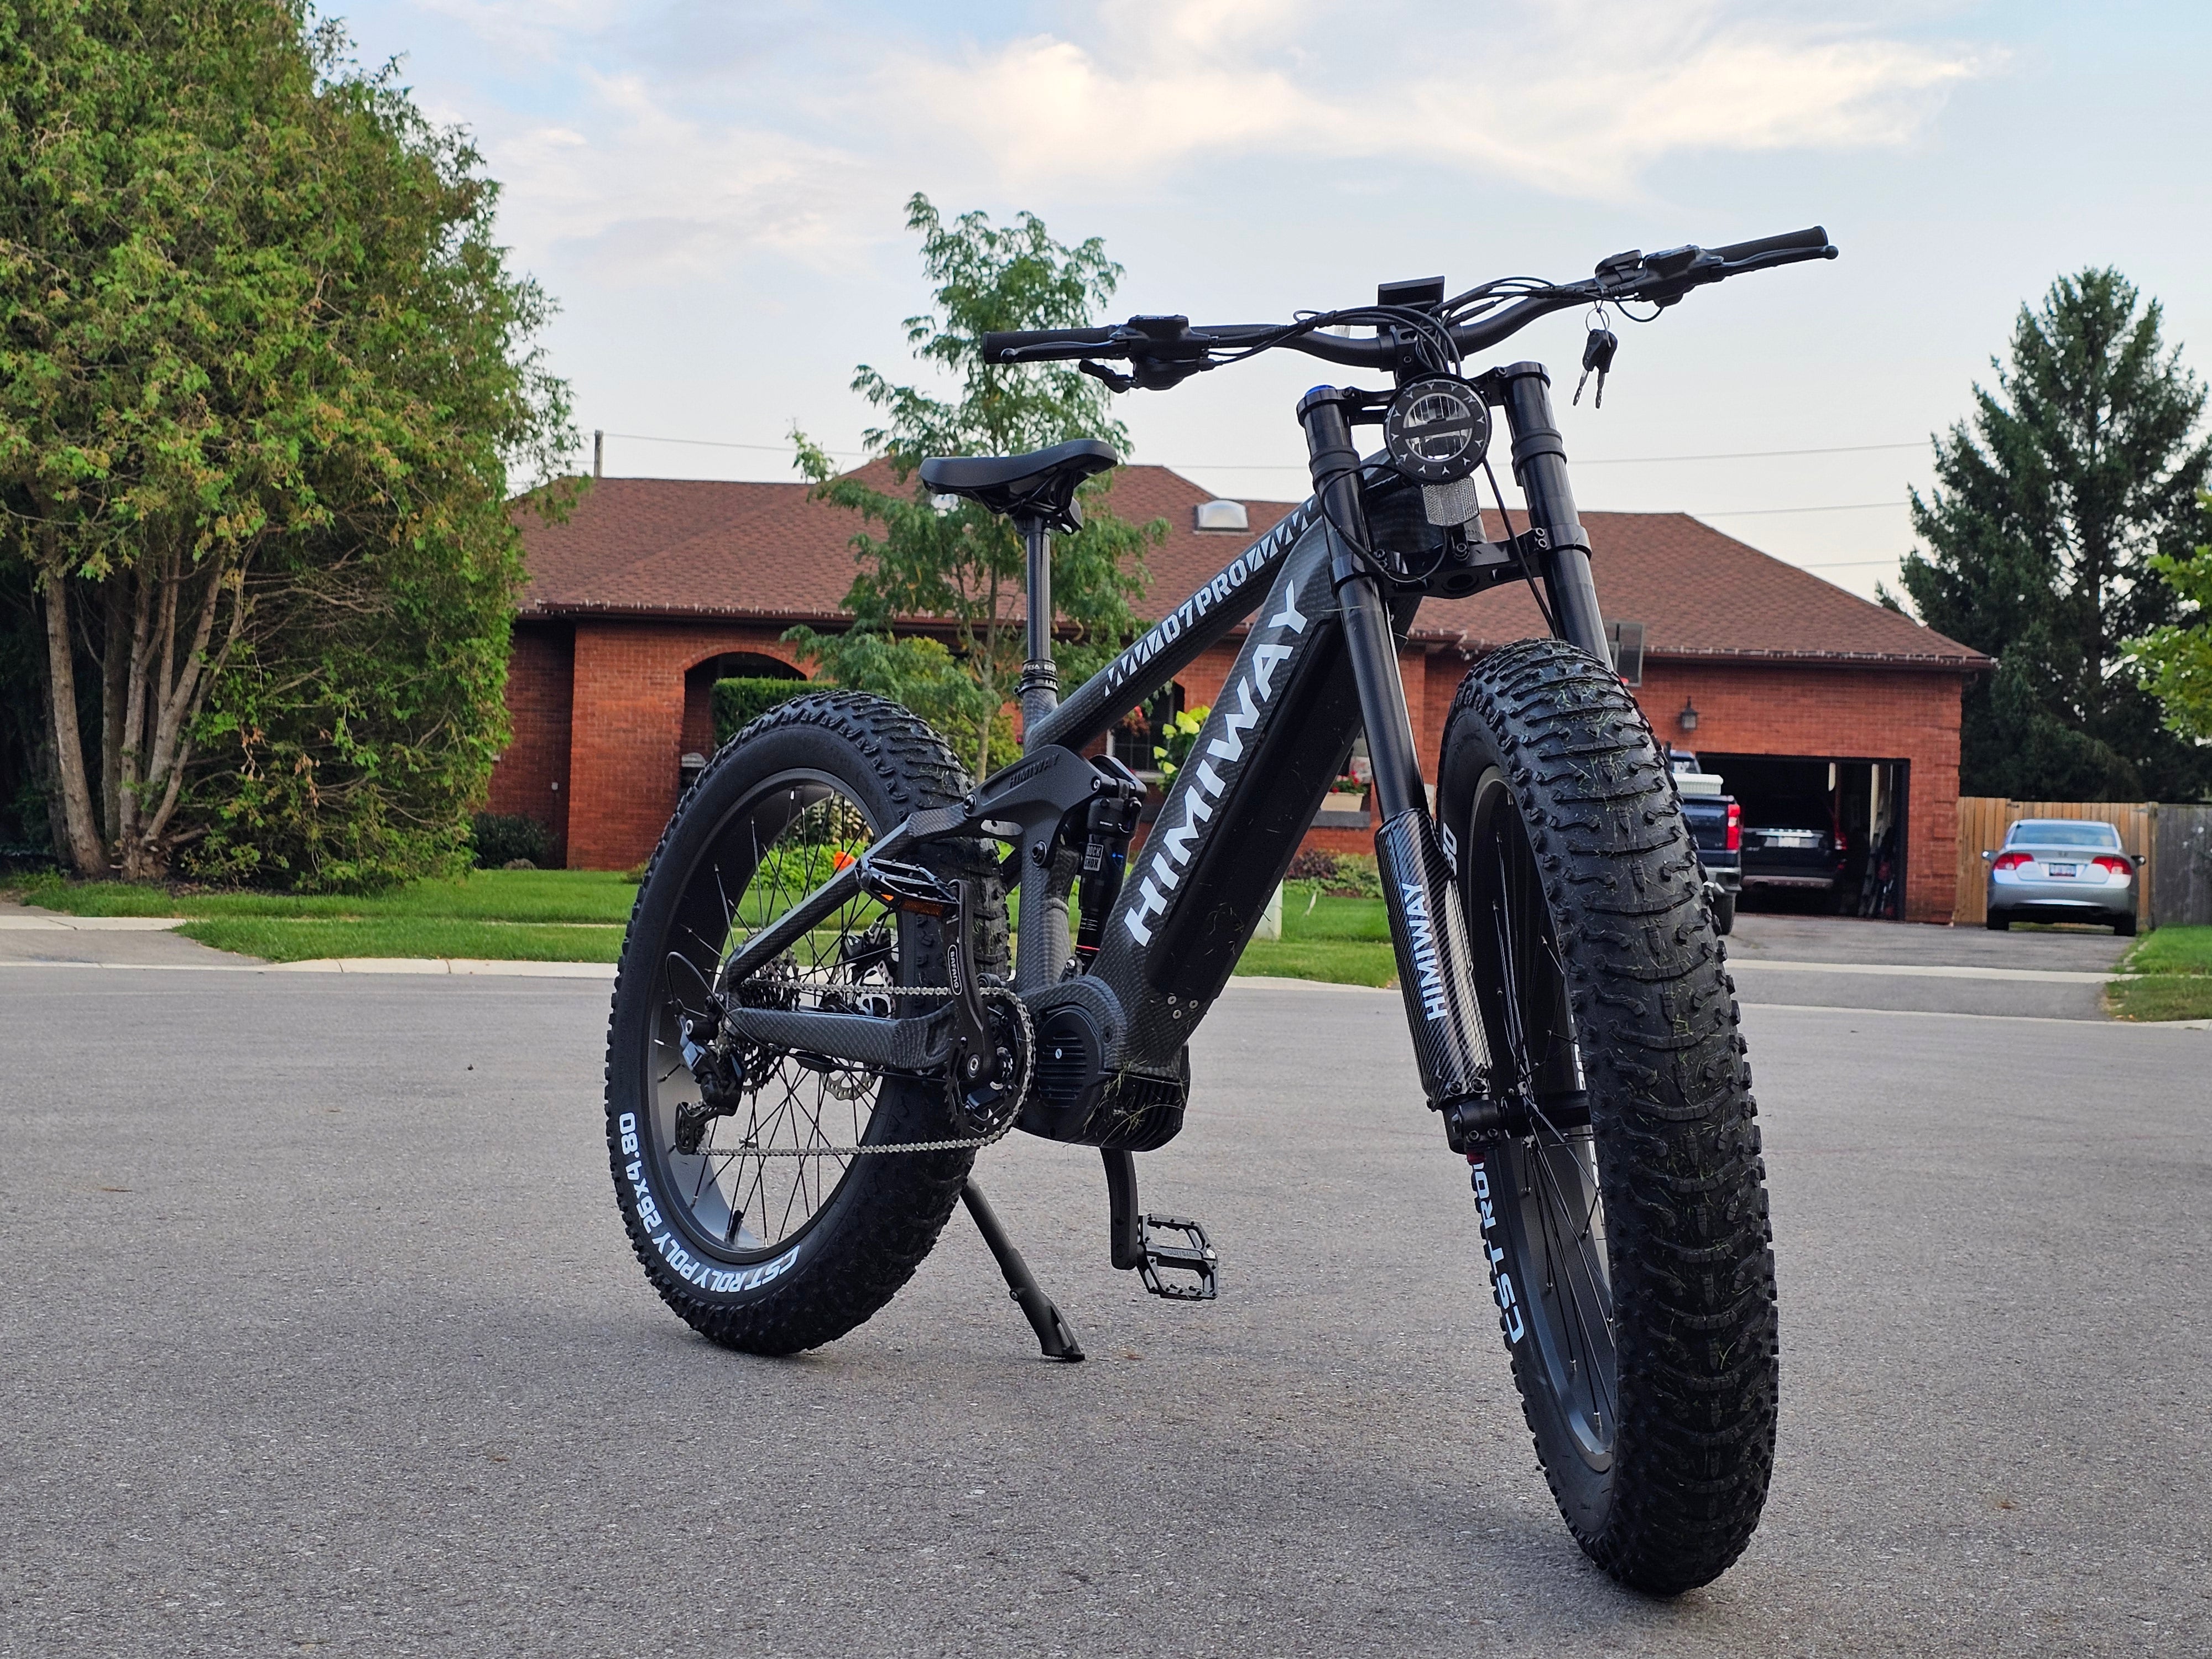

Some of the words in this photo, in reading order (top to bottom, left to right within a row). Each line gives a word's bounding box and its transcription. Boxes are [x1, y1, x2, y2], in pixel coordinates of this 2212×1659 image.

[1124, 578, 1308, 947] HIMIWAY
[950, 951, 960, 989] BAFANG
[1401, 882, 1448, 1021] HIMIWAY
[744, 1245, 801, 1291] CST
[1488, 1240, 1525, 1344] CST
